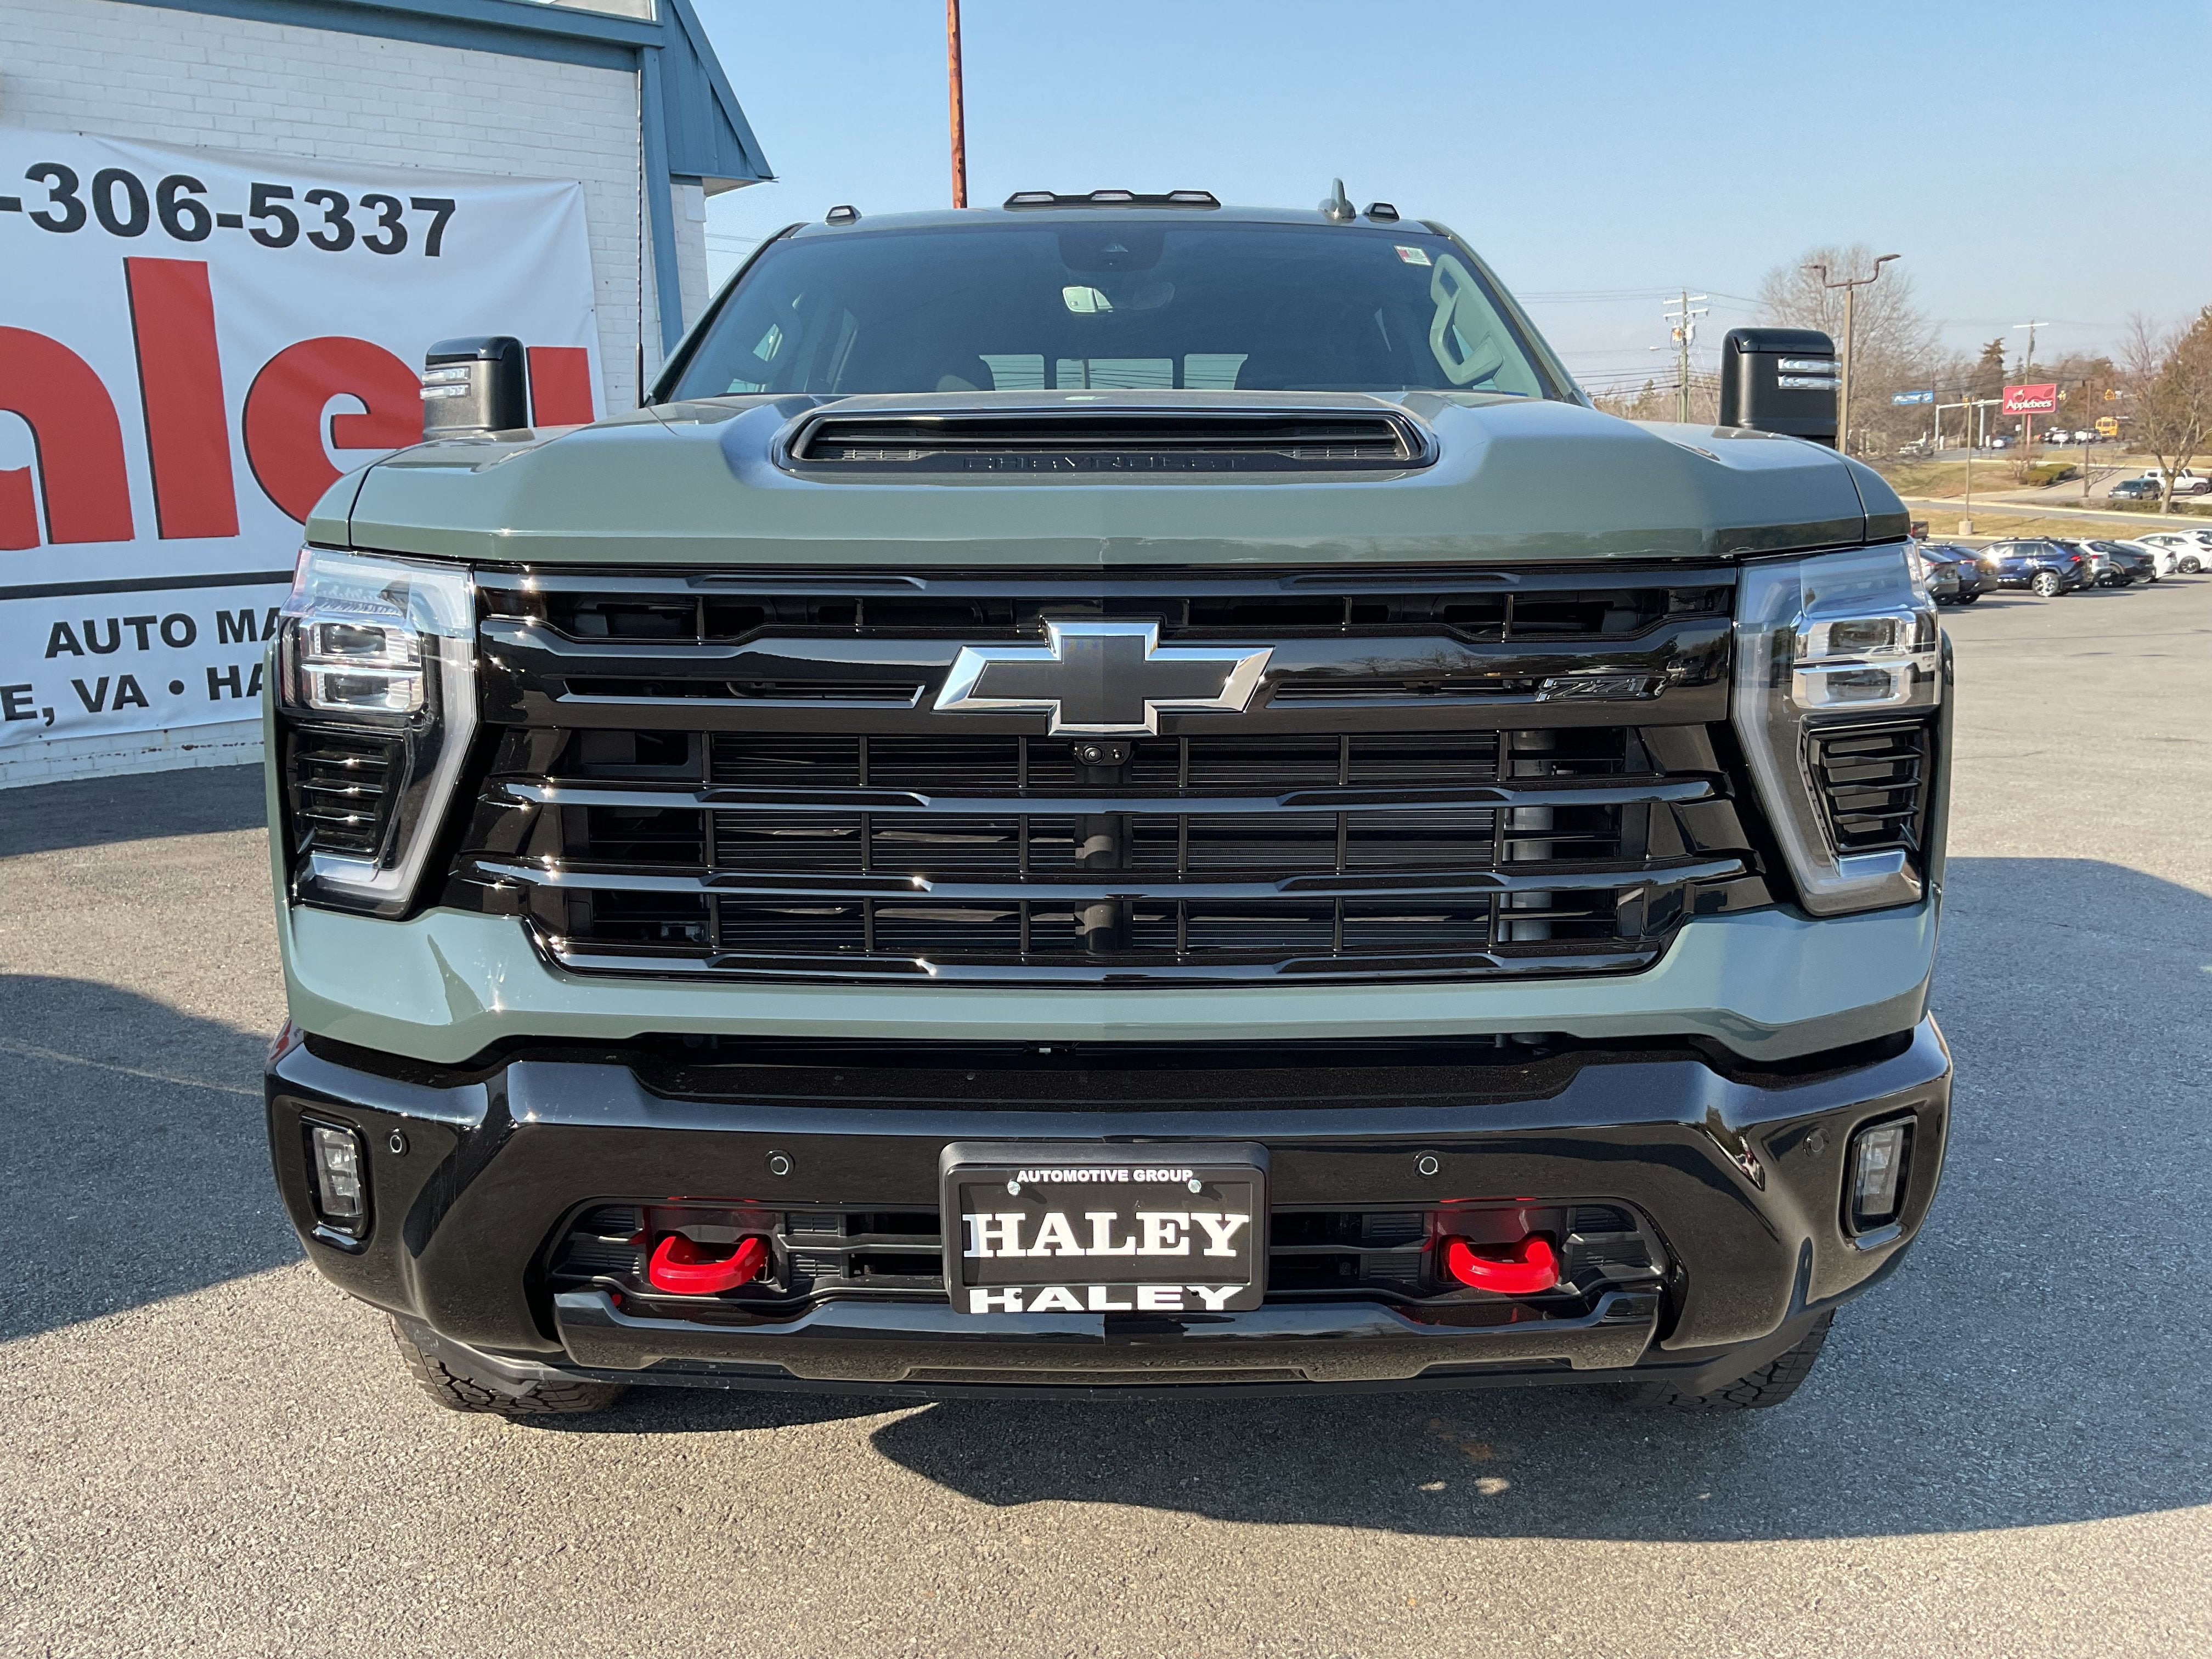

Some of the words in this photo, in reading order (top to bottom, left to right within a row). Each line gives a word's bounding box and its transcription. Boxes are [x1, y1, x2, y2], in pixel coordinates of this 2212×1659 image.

[0, 256, 595, 550] ale
[44, 613, 197, 658] AUTO
[71, 674, 150, 713] VA
[1016, 1169, 1129, 1182] AUTOMOTIVE
[1133, 1169, 1193, 1182] GROUP
[962, 1212, 1250, 1258] HALEY
[969, 1285, 1244, 1314] HALEY
